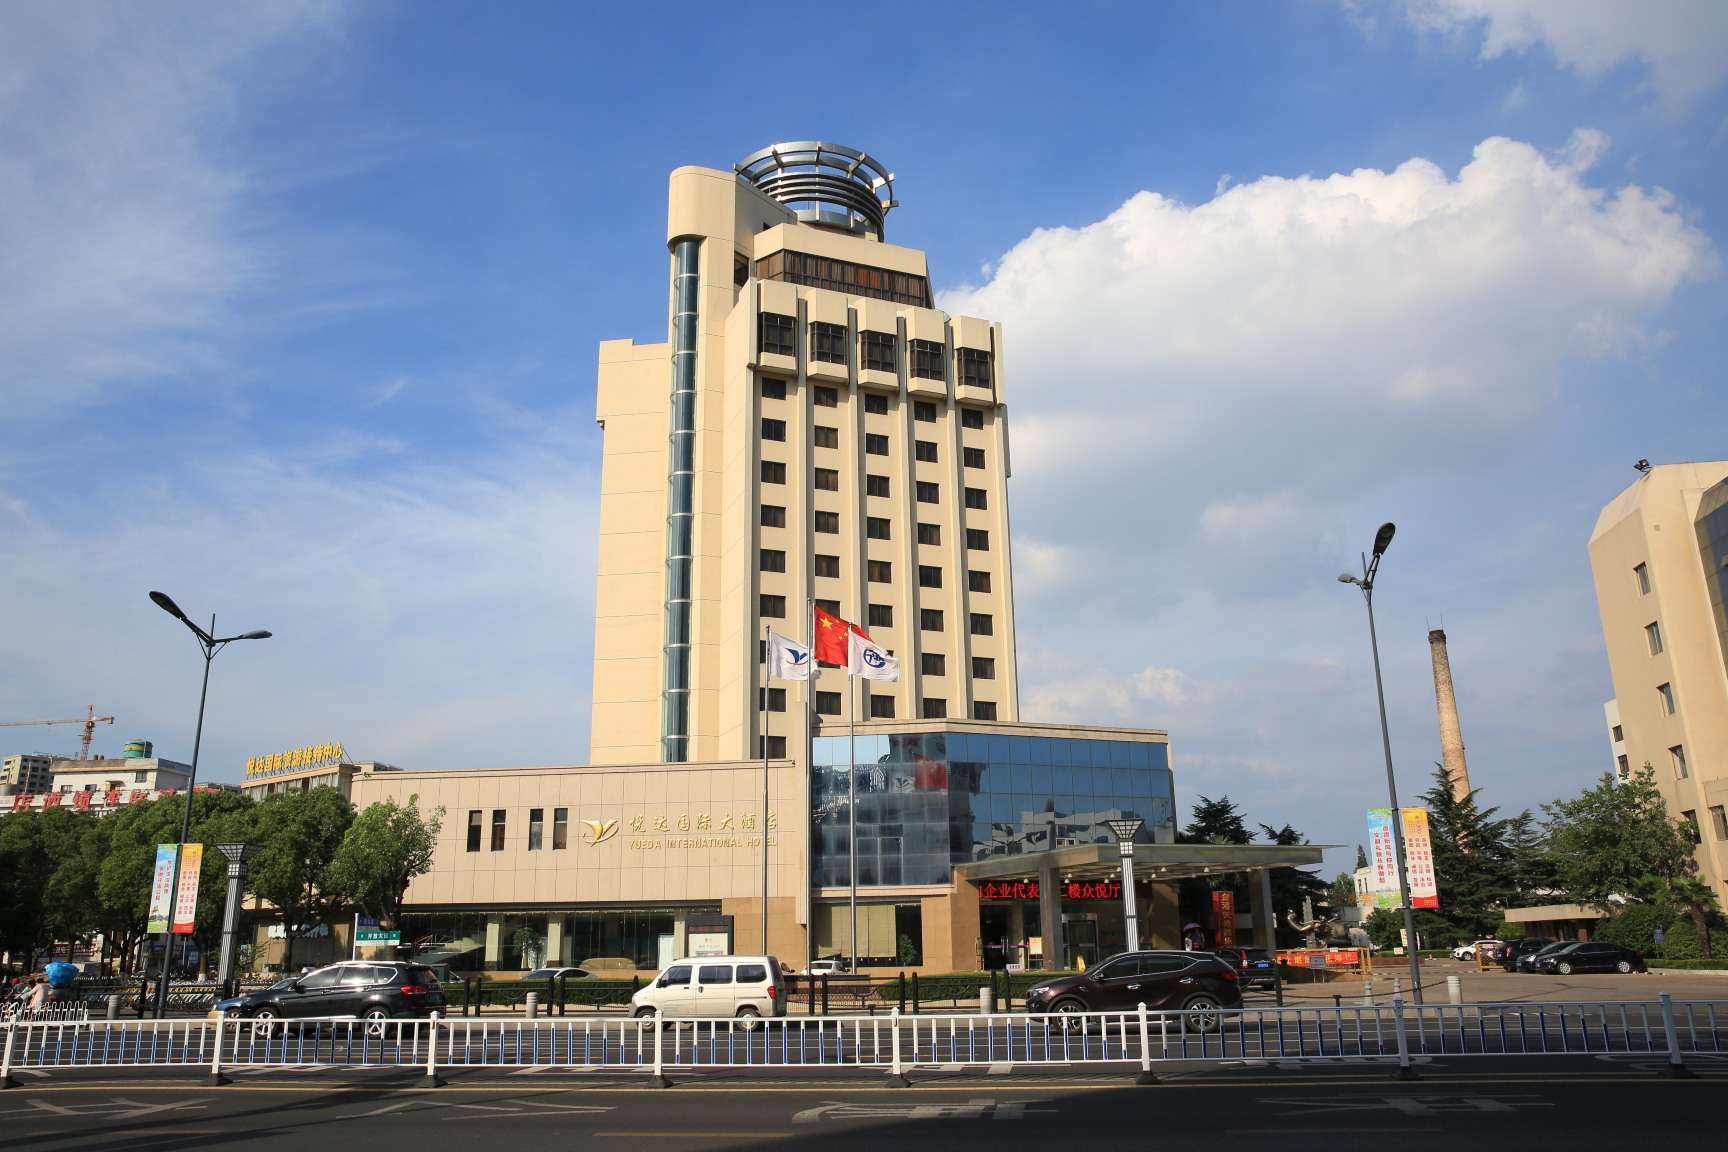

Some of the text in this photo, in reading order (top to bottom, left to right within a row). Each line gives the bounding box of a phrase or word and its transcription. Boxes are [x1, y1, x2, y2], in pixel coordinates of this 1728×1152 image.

[246, 741, 344, 775] 悦达国际旅游接待中心
[629, 836, 777, 850] YUEDA INTERNATIONAL HOEL
